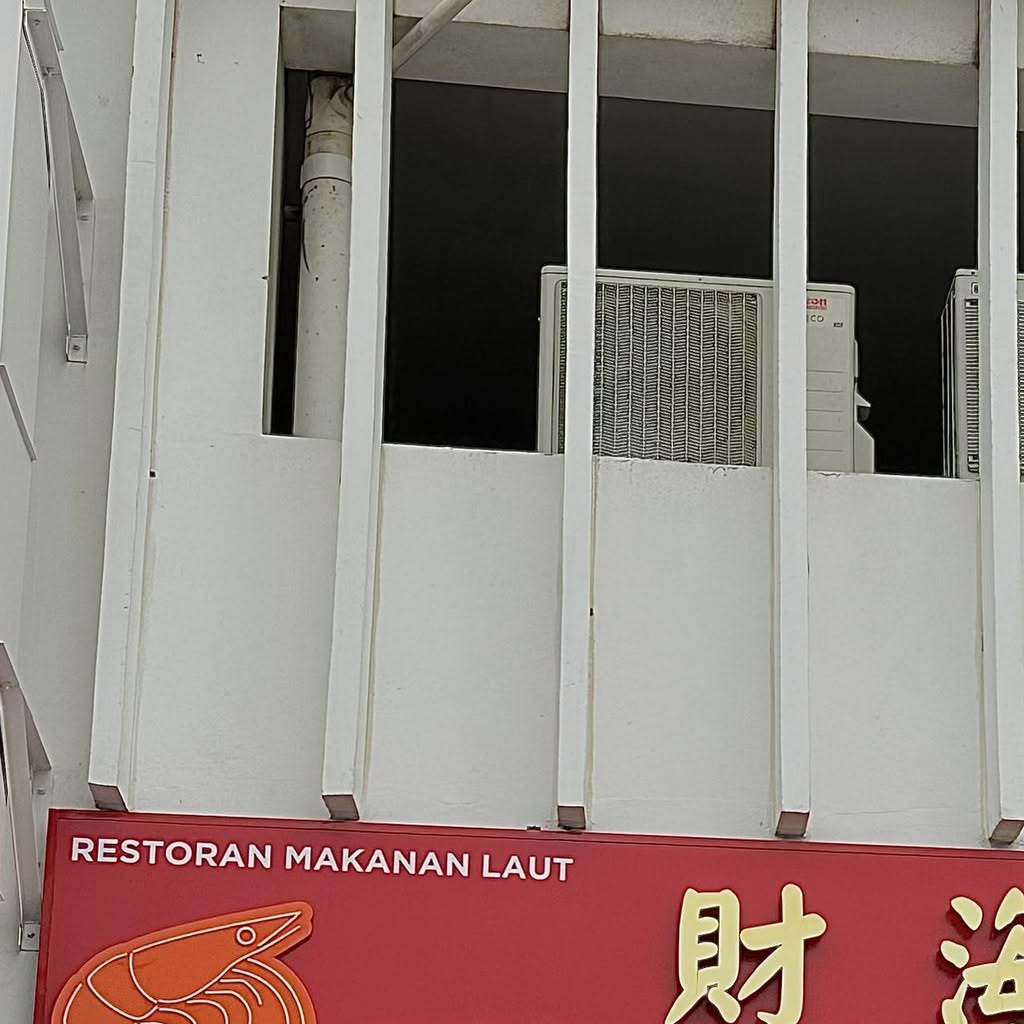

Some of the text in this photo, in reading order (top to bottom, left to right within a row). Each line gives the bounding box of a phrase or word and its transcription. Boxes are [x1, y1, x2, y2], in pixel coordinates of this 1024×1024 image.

[71, 837, 574, 881] RESTORAN MAKANAN LAUT
